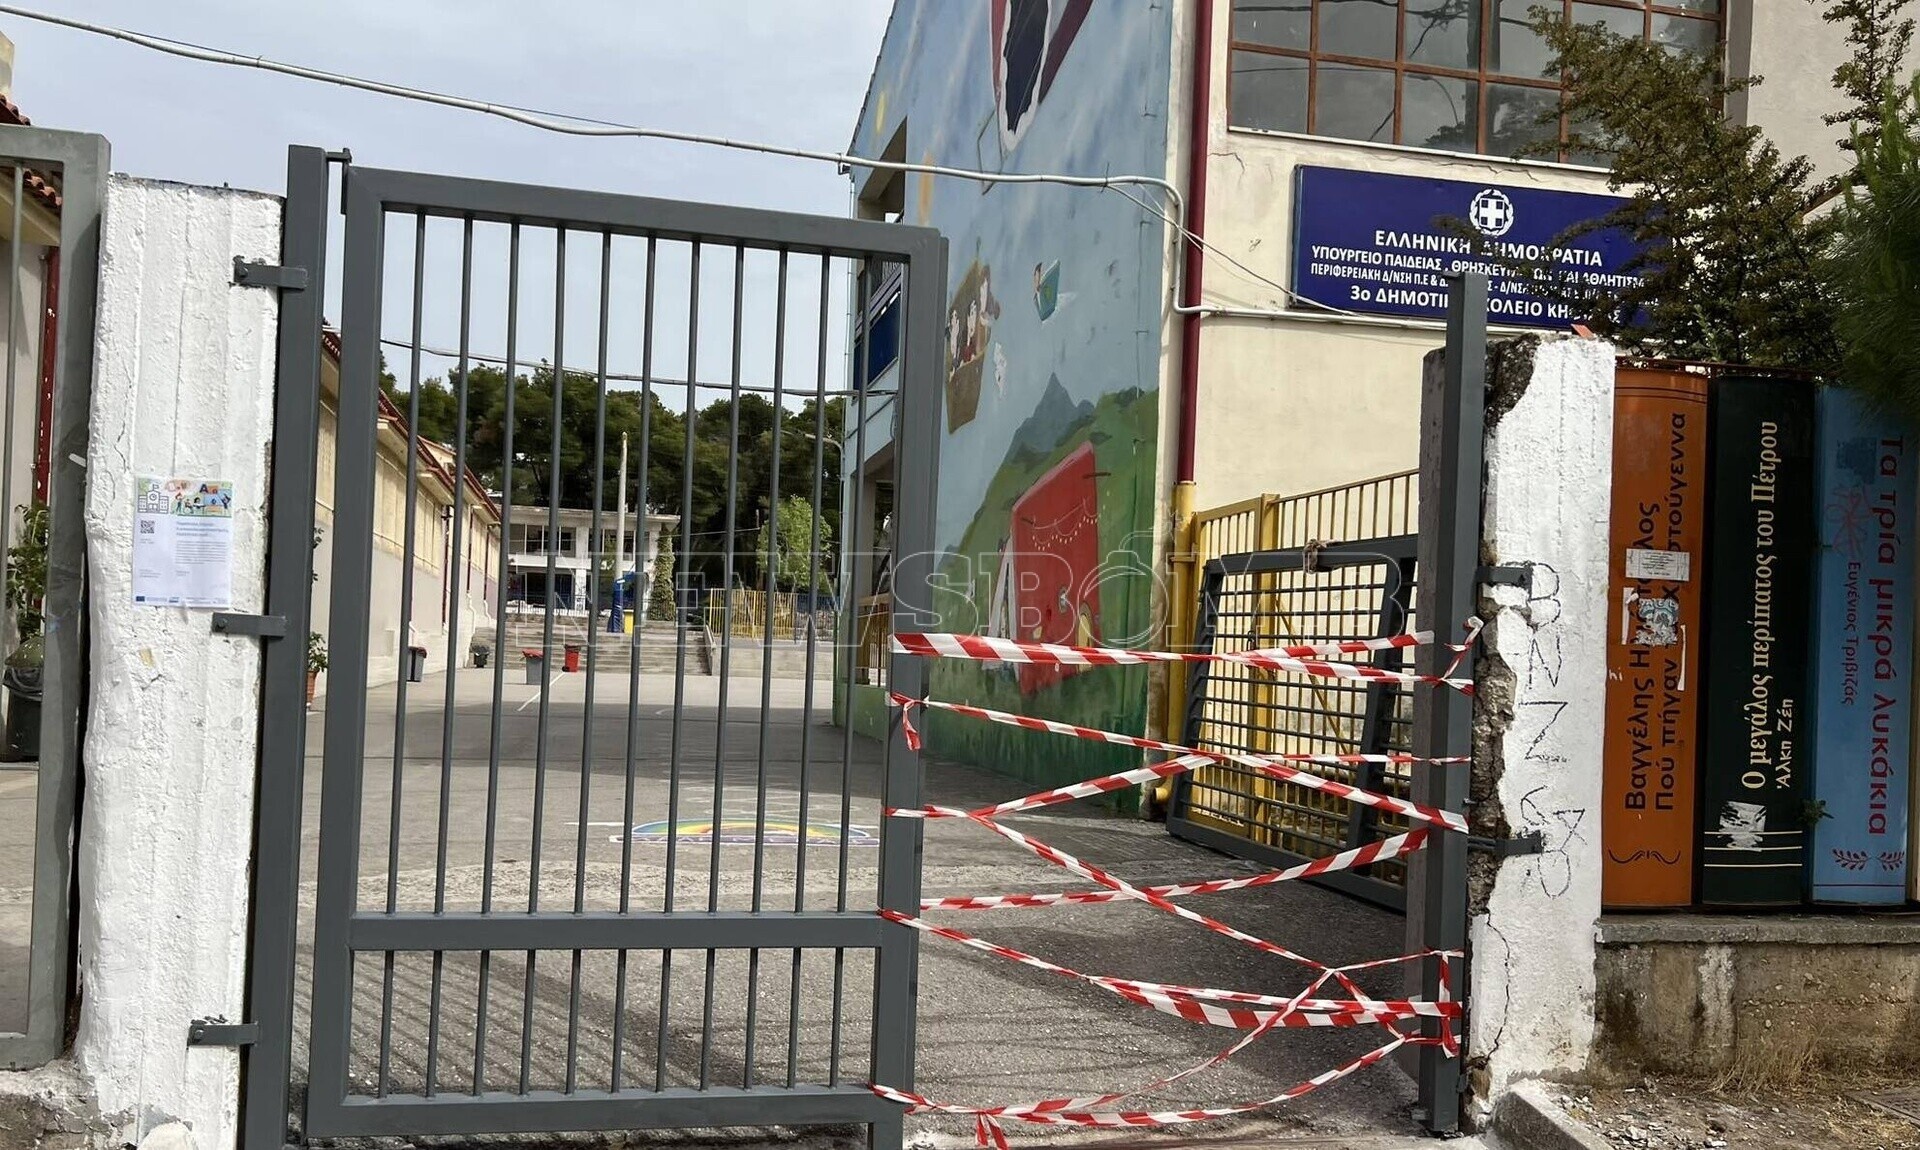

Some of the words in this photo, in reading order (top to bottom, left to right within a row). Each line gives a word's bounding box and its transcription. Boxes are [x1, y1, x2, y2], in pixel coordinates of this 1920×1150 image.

[1311, 263, 1380, 281] ΠΕΡΙΦΕΡΕΙΑΚΗ
[1382, 269, 1412, 284] Δ/ΝΣΗ
[1430, 276, 1438, 286] &
[1312, 245, 1382, 265] ΥΠΟΥΡΓΕΙΟ
[1385, 253, 1442, 271] ΠΑΙΔΕΙΑΣ
[1375, 230, 1471, 254] ΕΛΛΗΝΙΚΗ
[1375, 287, 1448, 308] ΔΗΜΟΤΙ
[1486, 299, 1543, 317] ΟΛΕΙΟ
[1751, 421, 1782, 503] Πέτρου
[1880, 436, 1903, 477] Τα
[1662, 412, 1688, 602] Χστούγεννα
[1756, 509, 1775, 548] του
[1871, 490, 1901, 565] τρία
[1747, 553, 1778, 668] περίπατος
[1843, 562, 1861, 632] Ευγένιος
[1867, 578, 1897, 680] μικρά
[1657, 658, 1681, 748] πήγαν
[1841, 636, 1859, 706] Τριβιζάς
[1625, 677, 1655, 811] Βαγγέλης
[1743, 673, 1774, 765] μεγάλος
[1655, 757, 1675, 811] Πού
[1741, 770, 1766, 789] Ο
[1868, 693, 1897, 835] λυκάκια
